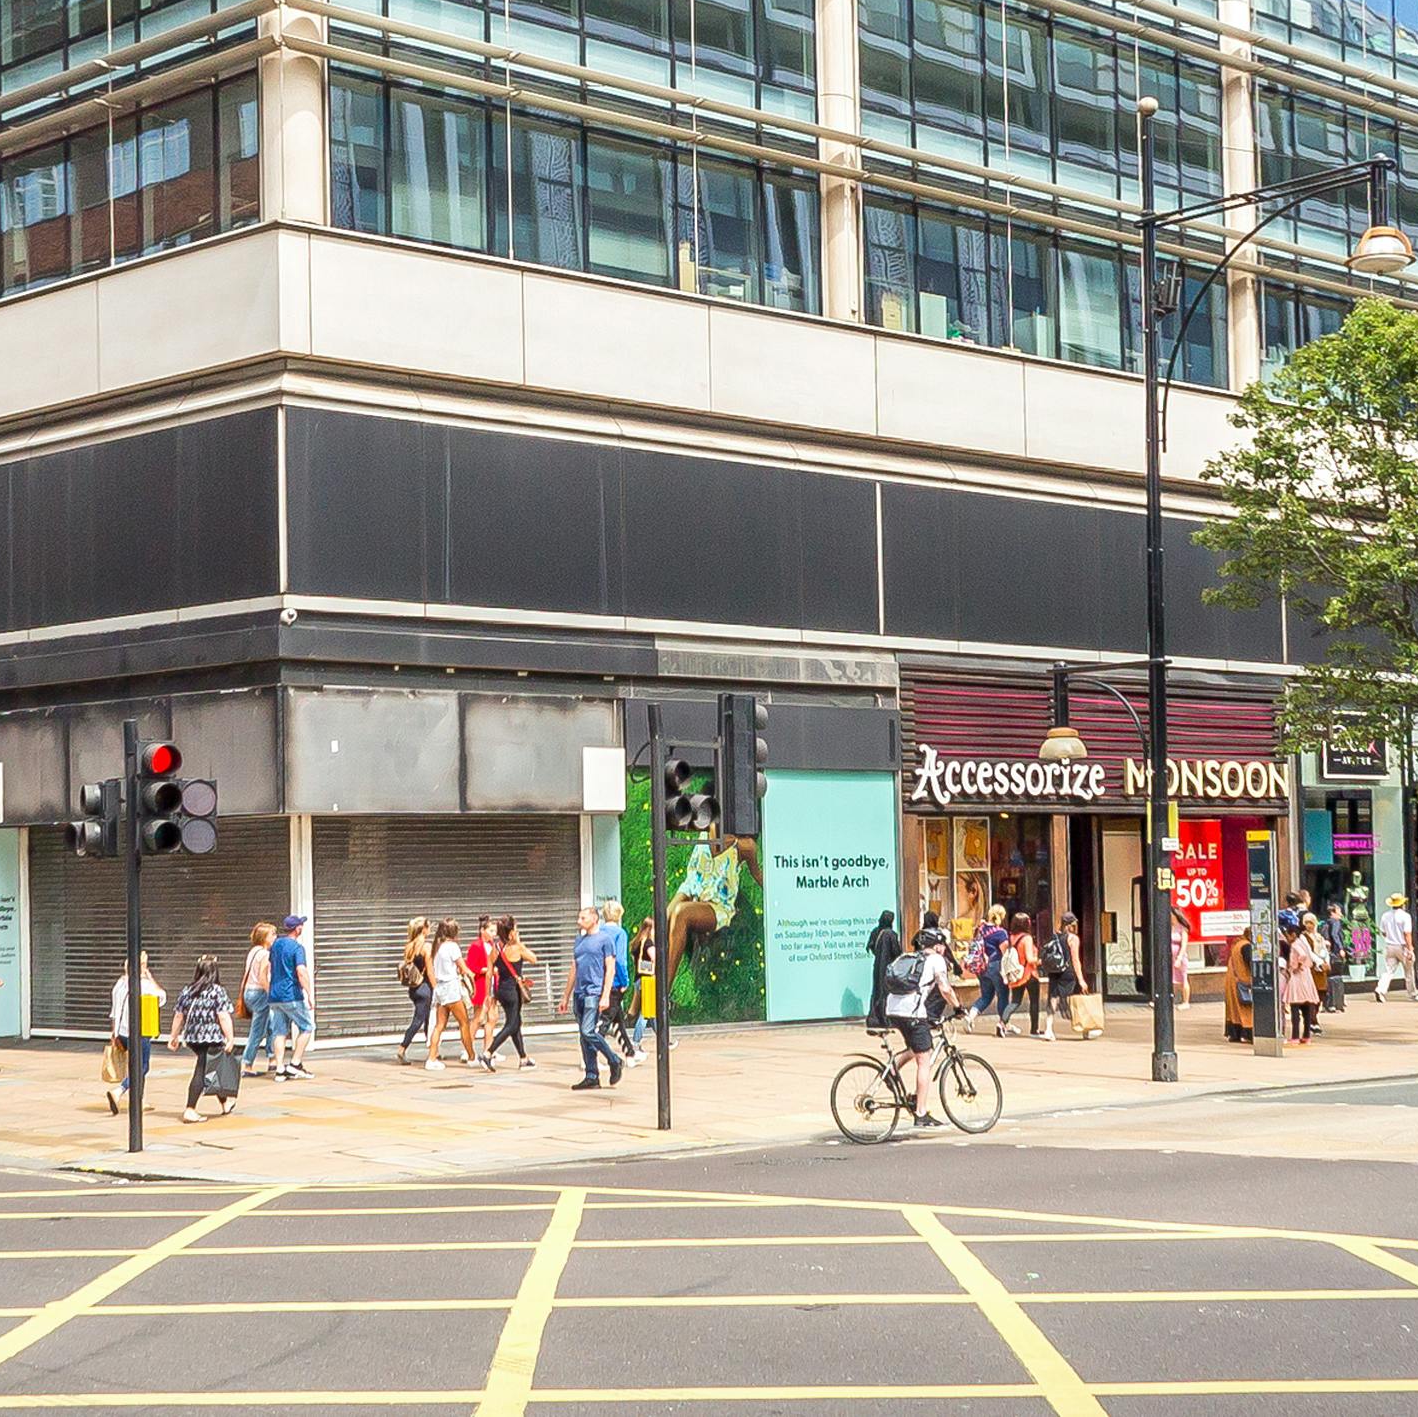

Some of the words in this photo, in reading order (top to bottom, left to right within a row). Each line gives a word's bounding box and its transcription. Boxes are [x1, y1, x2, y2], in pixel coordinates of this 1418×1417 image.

[911, 743, 1105, 805] Accessorize
[1175, 843, 1218, 860] SALE
[773, 855, 799, 868] This
[802, 855, 829, 868] isn't
[831, 854, 889, 871] goodbye,
[1186, 868, 1197, 876] UP
[796, 875, 839, 889] Marble
[842, 874, 870, 888] Arch
